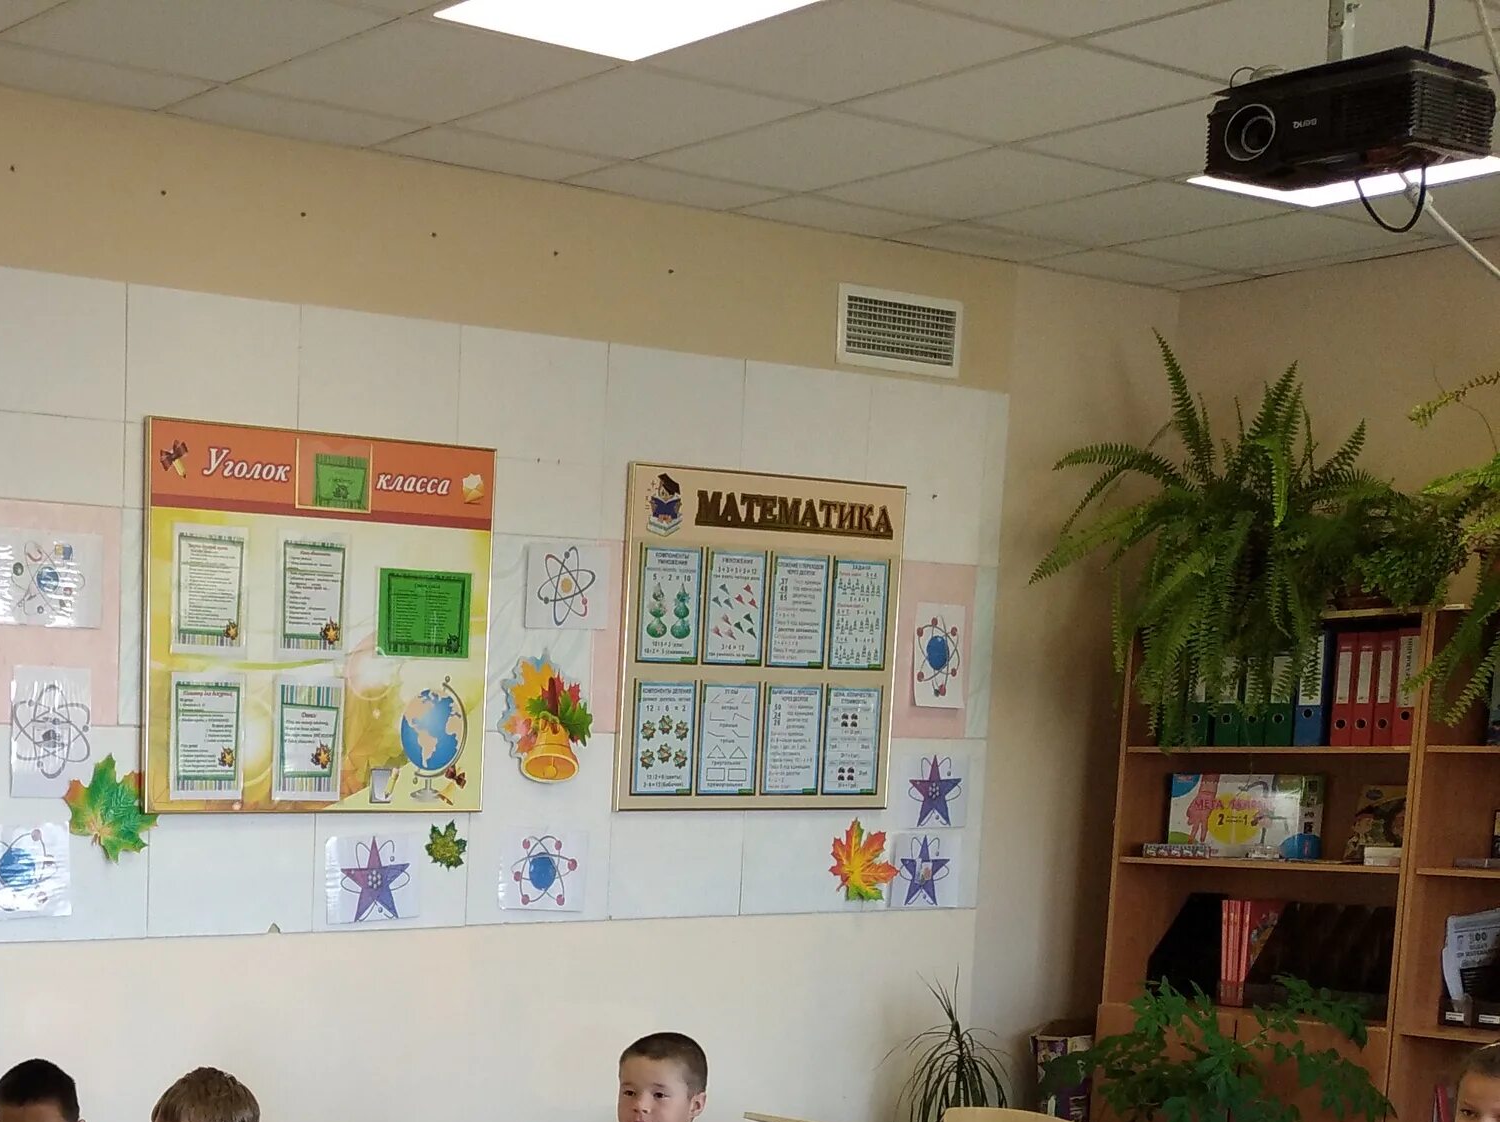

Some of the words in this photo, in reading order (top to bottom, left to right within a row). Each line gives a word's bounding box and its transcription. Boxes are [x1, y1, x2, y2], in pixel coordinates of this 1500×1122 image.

[202, 446, 292, 484] Уголок
[375, 471, 453, 497] класса
[695, 488, 894, 538] МАТЕМАТИКА
[1194, 798, 1223, 810] МЕГА
[1217, 813, 1225, 826] 2
